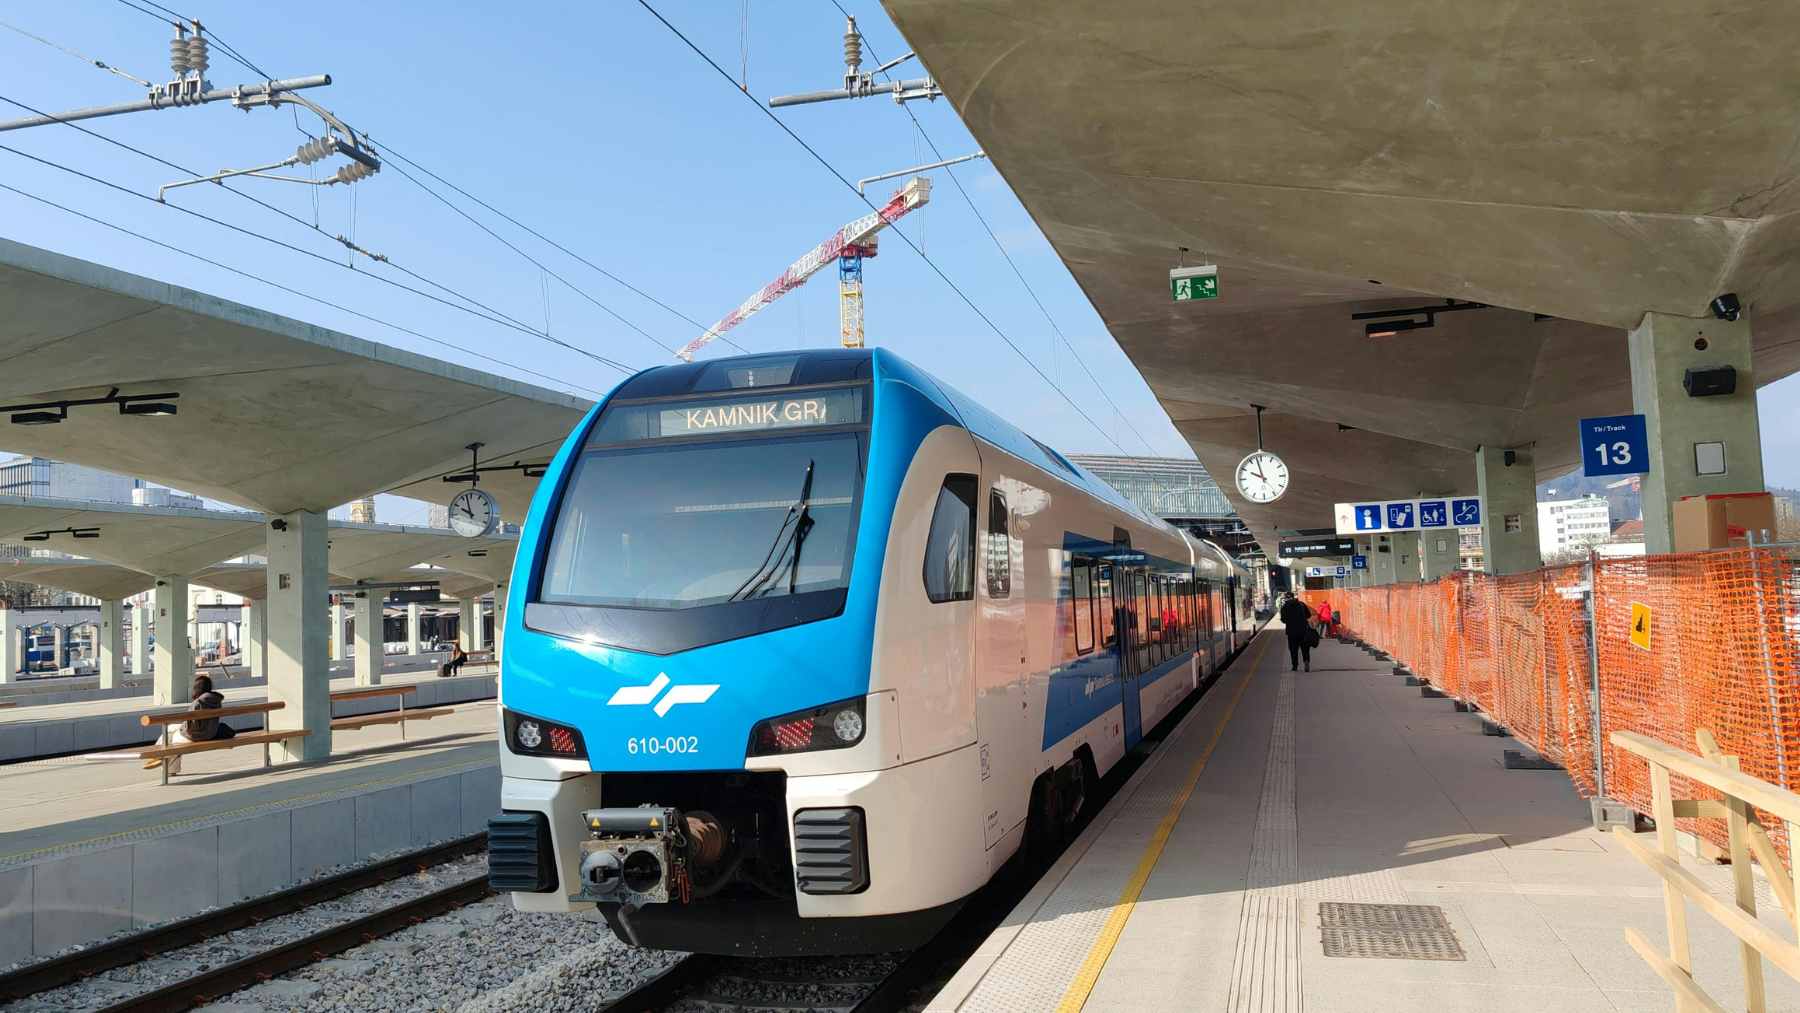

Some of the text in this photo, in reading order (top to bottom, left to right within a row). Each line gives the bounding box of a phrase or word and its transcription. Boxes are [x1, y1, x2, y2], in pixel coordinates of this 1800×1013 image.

[686, 403, 778, 430] KAMNIK
[1595, 441, 1632, 465] 13
[627, 736, 699, 755] 610-002
